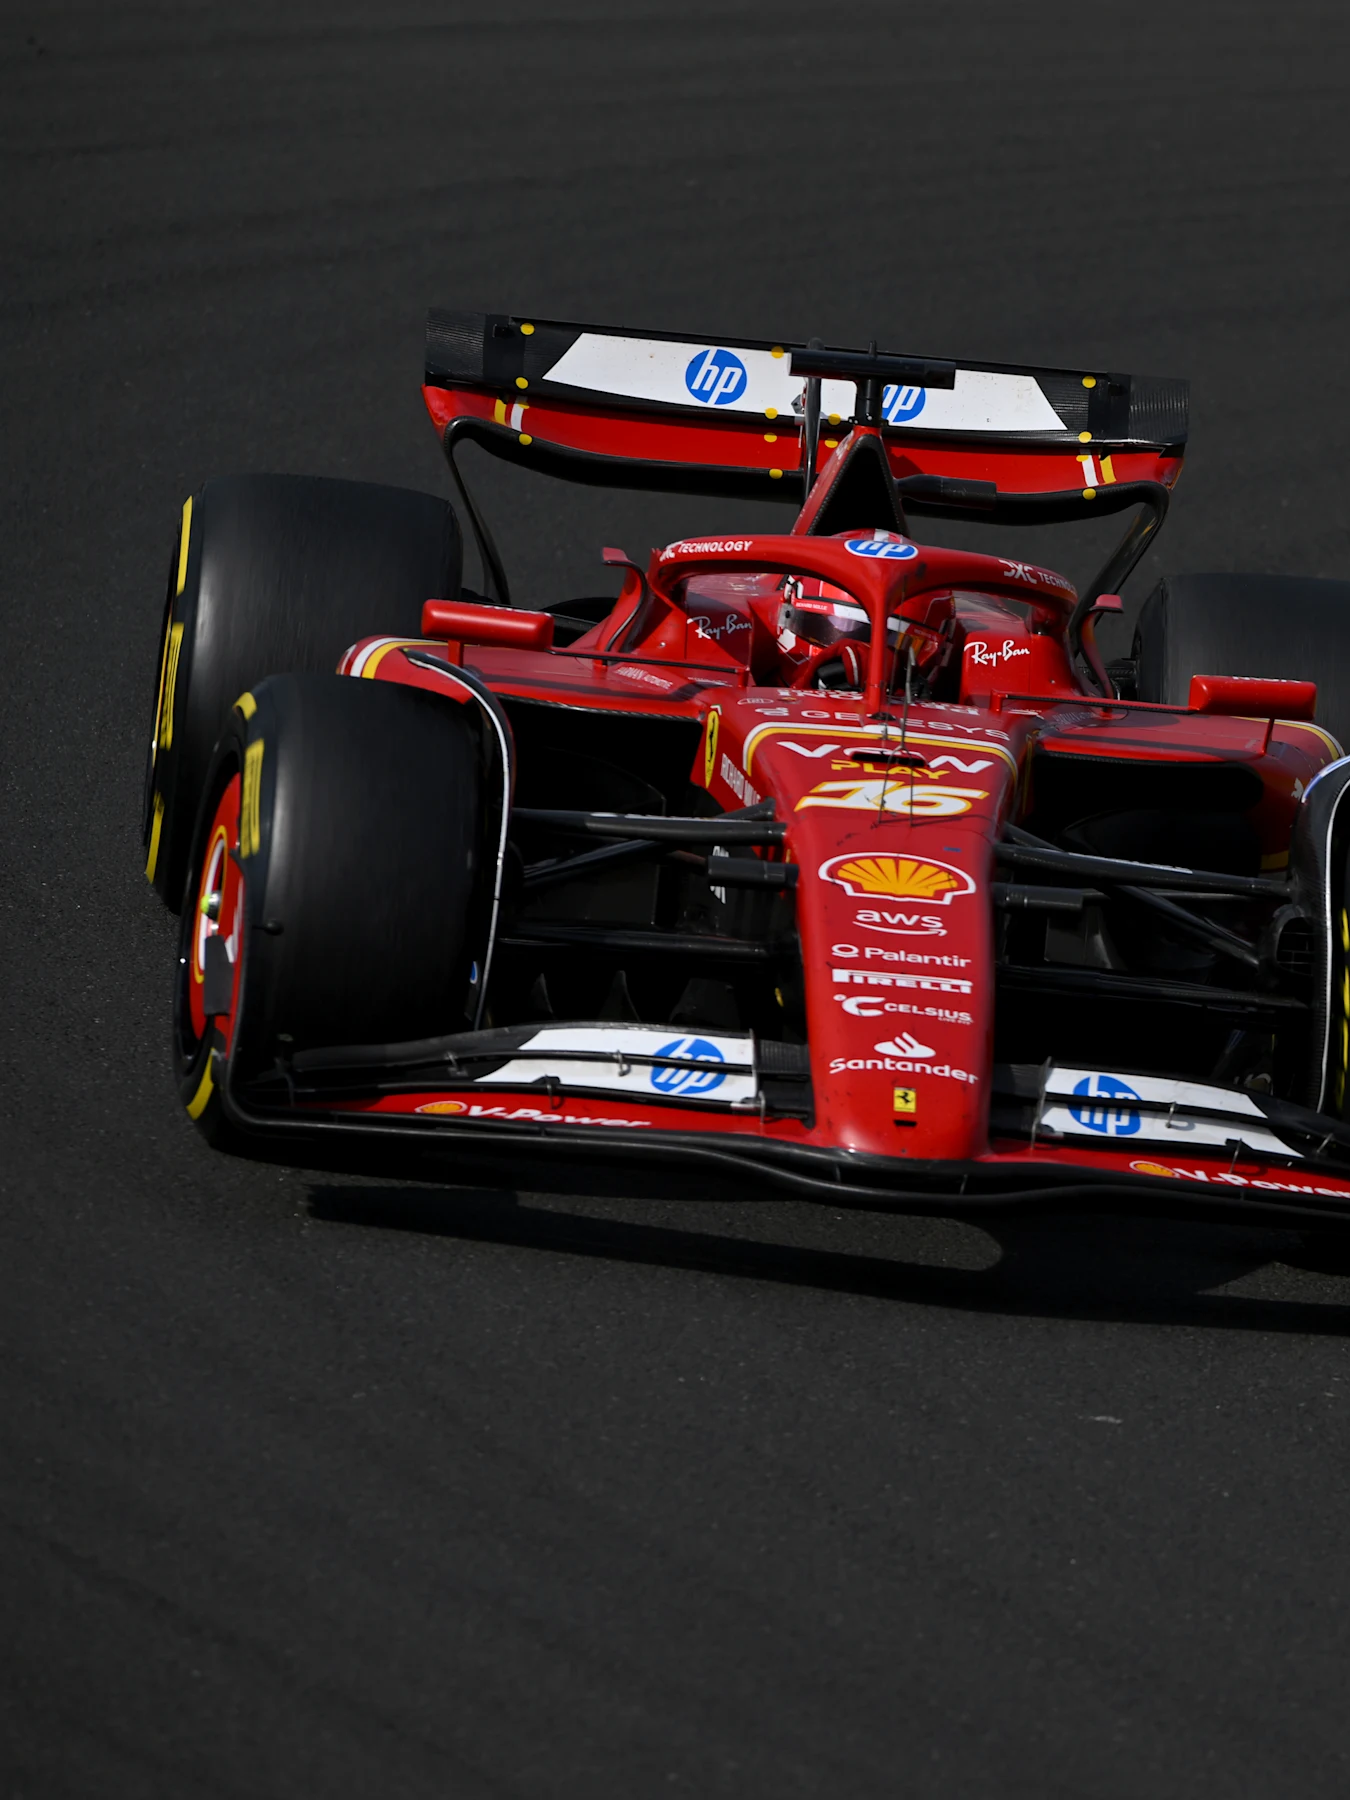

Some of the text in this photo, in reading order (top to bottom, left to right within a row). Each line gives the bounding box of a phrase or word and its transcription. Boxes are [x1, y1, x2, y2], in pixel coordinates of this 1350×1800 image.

[690, 349, 743, 406] hp
[678, 541, 753, 553] TECHNOLOGY
[687, 614, 752, 640] Ray-Ban
[964, 640, 1030, 667] Ray-Ban
[801, 709, 1011, 742] GEESYS
[831, 759, 950, 780] PLAY
[794, 778, 991, 817] 16
[855, 910, 944, 931] aws
[864, 946, 972, 968] Palantir
[832, 968, 974, 994] PIRELLI
[884, 1003, 973, 1022] CELSIUS
[829, 1057, 979, 1084] Santander
[465, 1105, 652, 1128] V-Power
